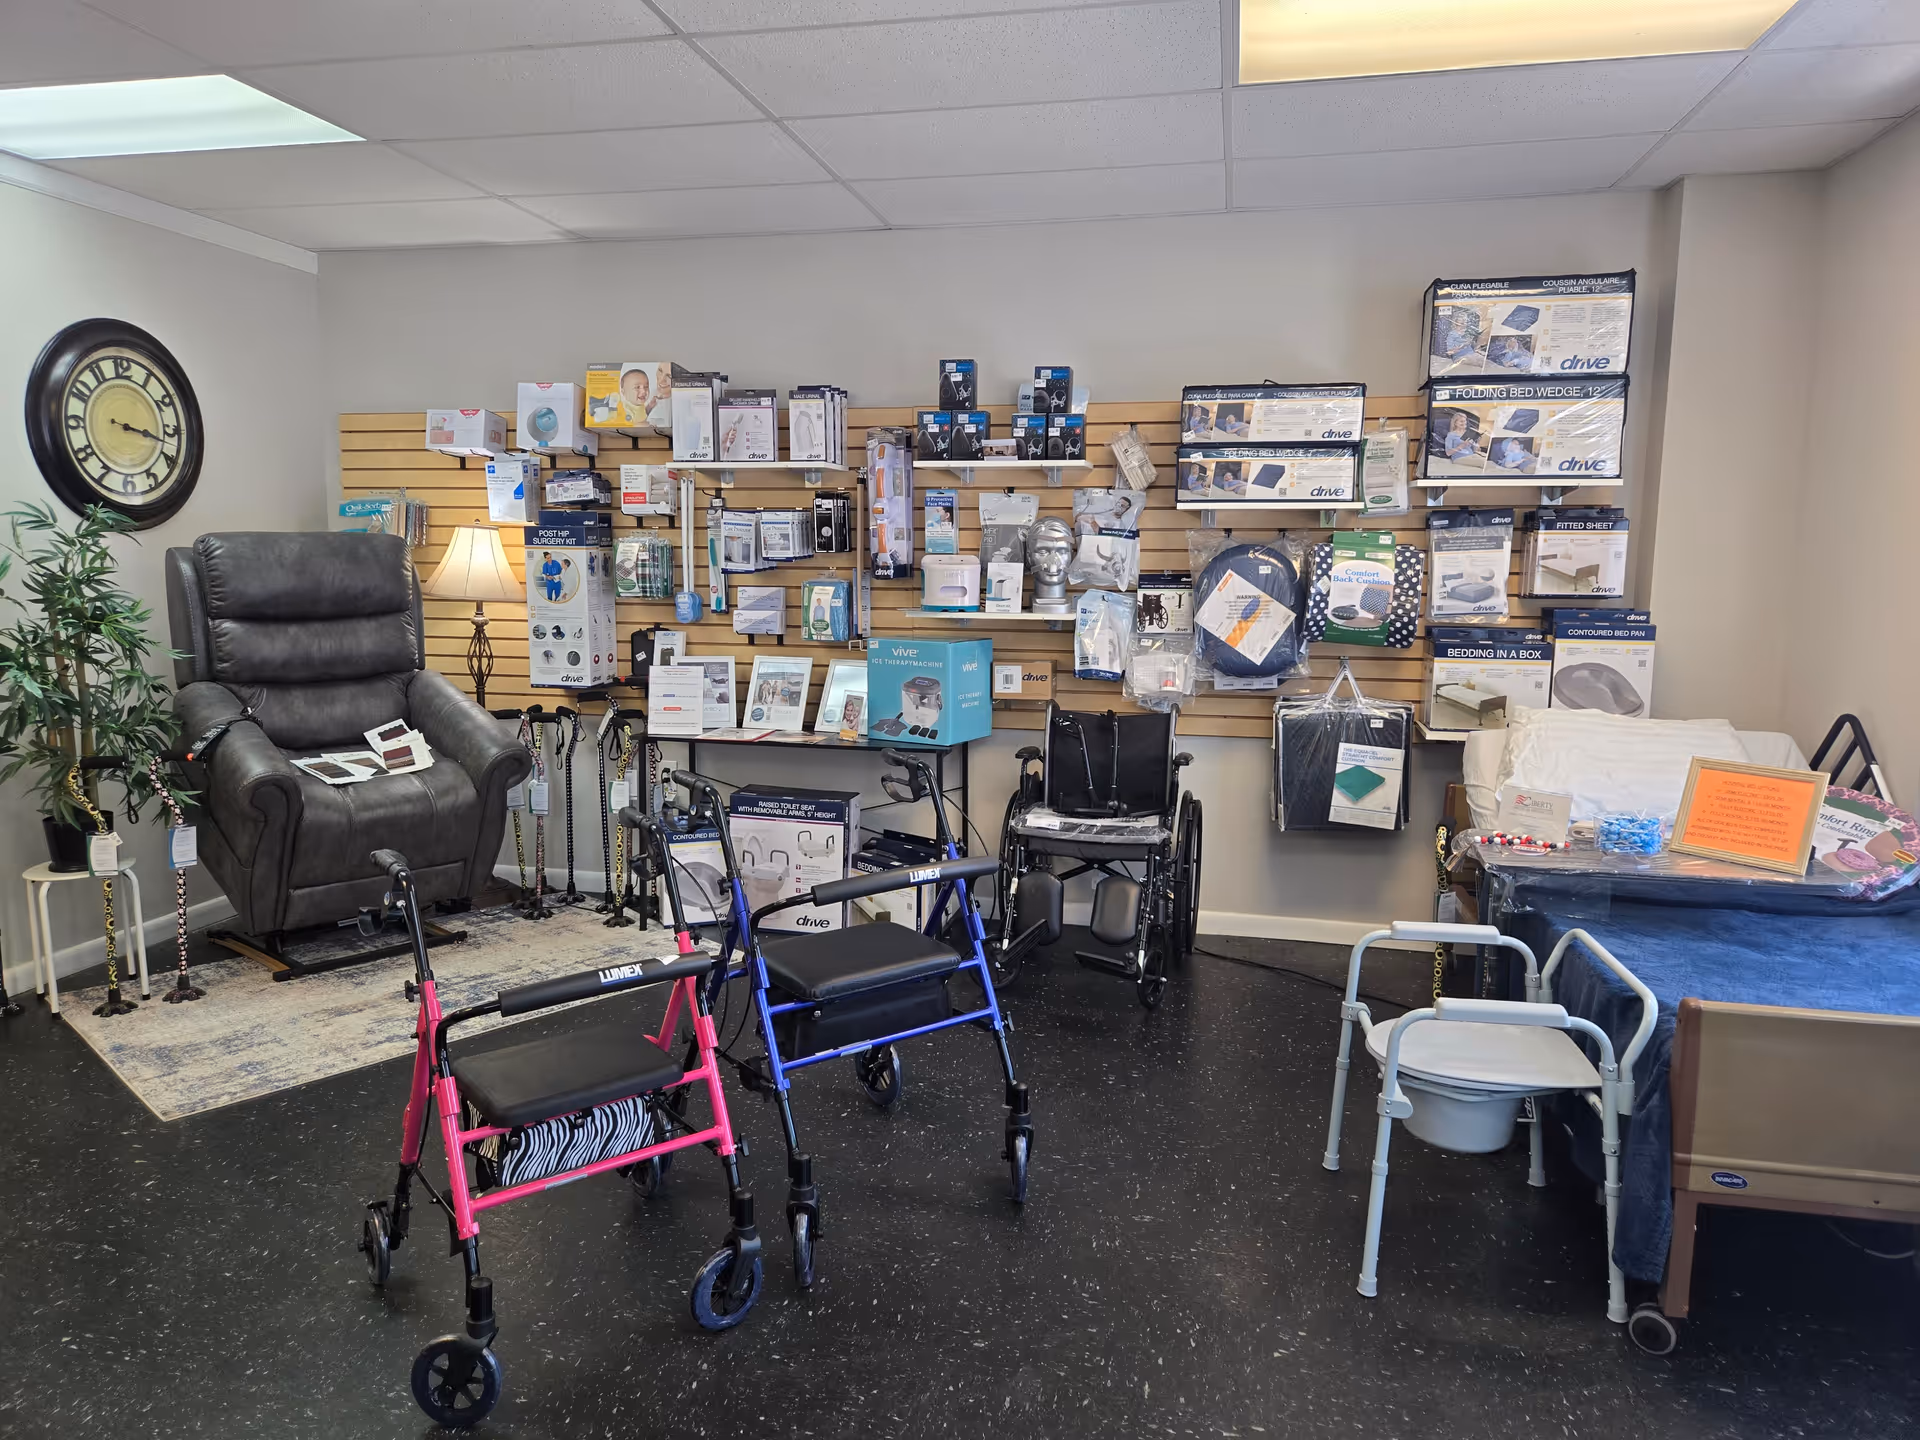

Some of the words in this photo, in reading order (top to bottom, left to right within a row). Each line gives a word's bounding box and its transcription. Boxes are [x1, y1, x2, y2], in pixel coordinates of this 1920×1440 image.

[1472, 281, 1510, 289] PLEGABLE
[1542, 279, 1576, 287] COUSSIN
[1578, 277, 1620, 285] ANGULAIRE
[1559, 354, 1610, 370] drive
[88, 363, 108, 384] 11
[112, 358, 133, 379] 12
[141, 371, 153, 388] 1
[71, 379, 93, 403] 10
[1455, 387, 1506, 398] FOLDING
[1509, 387, 1534, 398] BED
[1536, 386, 1584, 398] WEDGE,
[155, 393, 173, 413] 2
[66, 414, 84, 430] 9
[163, 423, 178, 438] 3
[1321, 429, 1352, 440] drive
[75, 444, 95, 463] 8
[689, 451, 708, 459] drive
[748, 451, 767, 459] drive
[1224, 449, 1256, 458] FOLDING
[1258, 449, 1274, 457] BED
[162, 450, 176, 469] 4
[1558, 456, 1607, 472] drive
[96, 465, 111, 484] 7
[145, 469, 160, 488] 5
[122, 474, 136, 494] 6
[1310, 485, 1344, 497] drive
[1491, 516, 1512, 524] drive
[1556, 522, 1584, 530] FITTED
[1585, 522, 1613, 530] SHEET
[538, 529, 557, 537] POST
[532, 537, 565, 545] SURGERY
[566, 537, 576, 545] KIT
[875, 568, 894, 576] drive
[1345, 568, 1379, 577] Comfort
[1333, 575, 1353, 583] Back
[1591, 585, 1616, 594] drive
[1472, 604, 1497, 612] drive
[1567, 628, 1613, 636] CONTOURED
[1630, 629, 1646, 637] PAN
[892, 646, 917, 657] vive
[1447, 648, 1494, 658] BEDDING
[1496, 649, 1507, 658] IN
[1509, 649, 1517, 658] A
[1519, 650, 1542, 659] BOX
[962, 661, 978, 672] vive
[561, 673, 583, 683] drive
[1022, 672, 1048, 681] drive
[753, 807, 787, 815] REMOVABLE
[1821, 823, 1866, 840] Comfortable
[1849, 821, 1878, 838] Ring
[857, 861, 883, 873] BEDDING
[909, 867, 941, 883] LUMEX
[796, 915, 830, 928] drive
[598, 962, 642, 983] LUMEX
